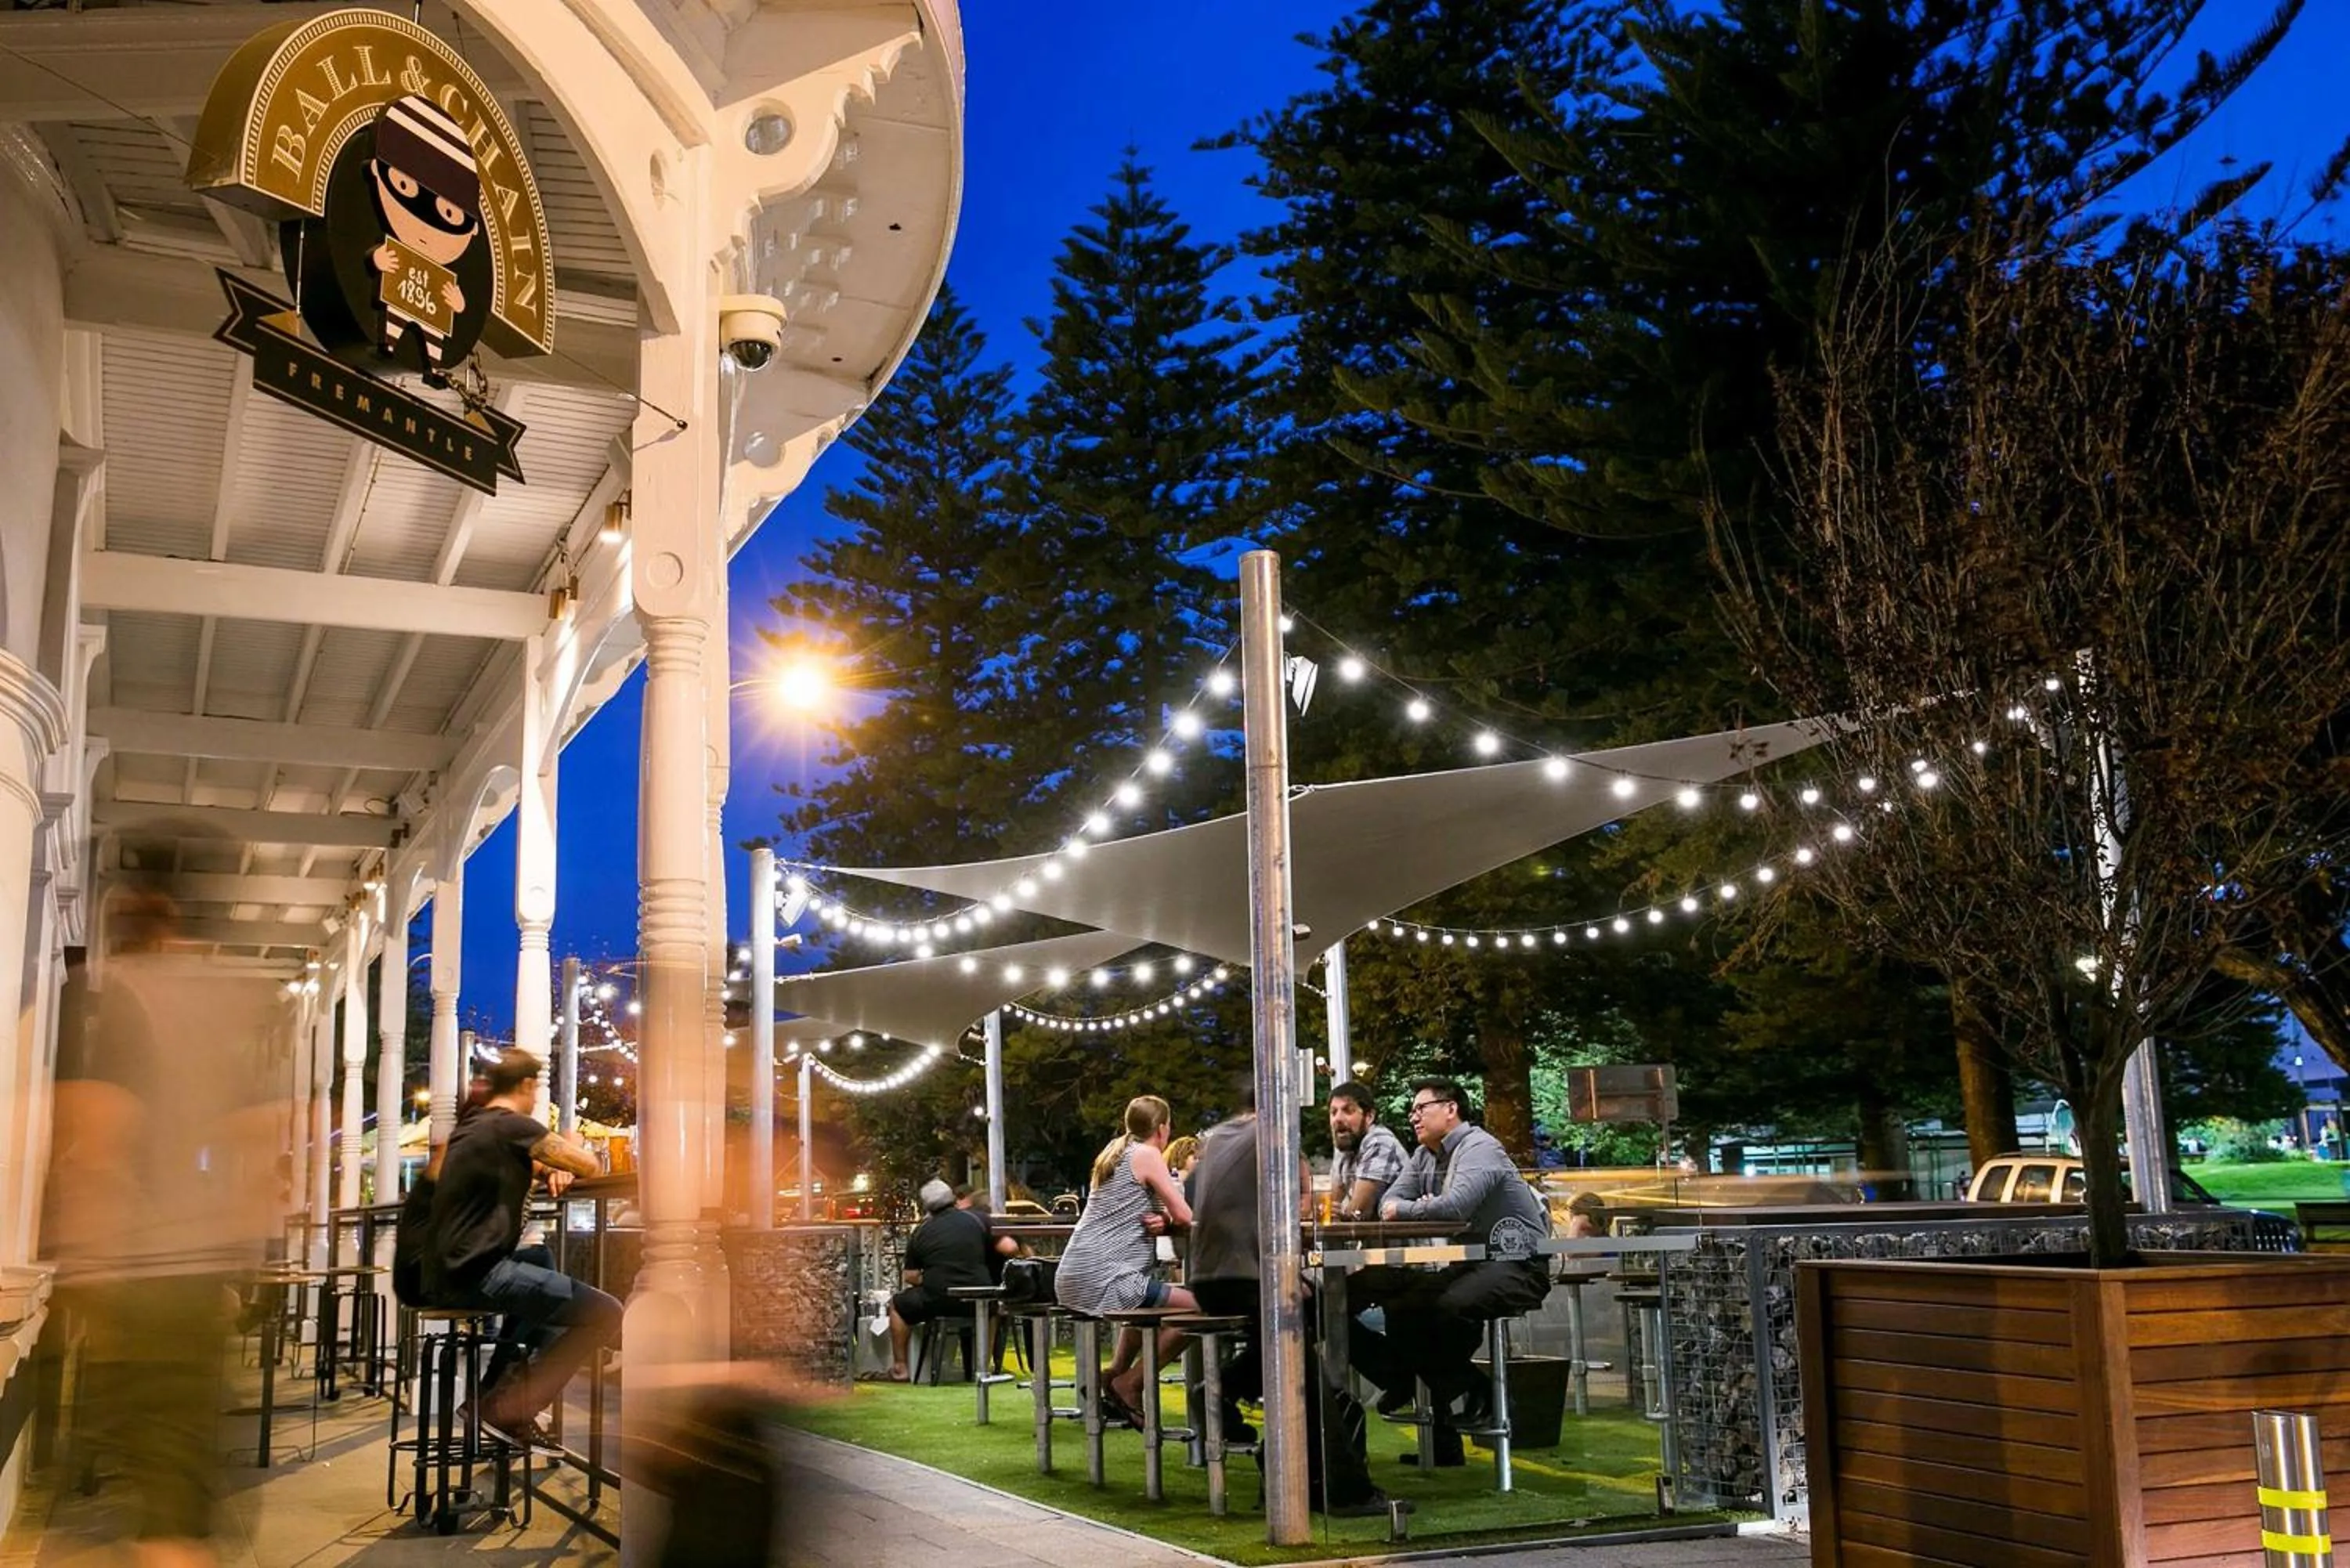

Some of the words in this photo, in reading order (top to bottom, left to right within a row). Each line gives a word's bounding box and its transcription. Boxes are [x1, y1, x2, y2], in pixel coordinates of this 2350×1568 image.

[271, 45, 392, 182] BALL
[400, 55, 431, 97] &
[439, 84, 537, 316] CHAIN
[397, 280, 436, 315] 1896
[408, 267, 429, 288] est
[287, 362, 473, 461] FREMANTLE
